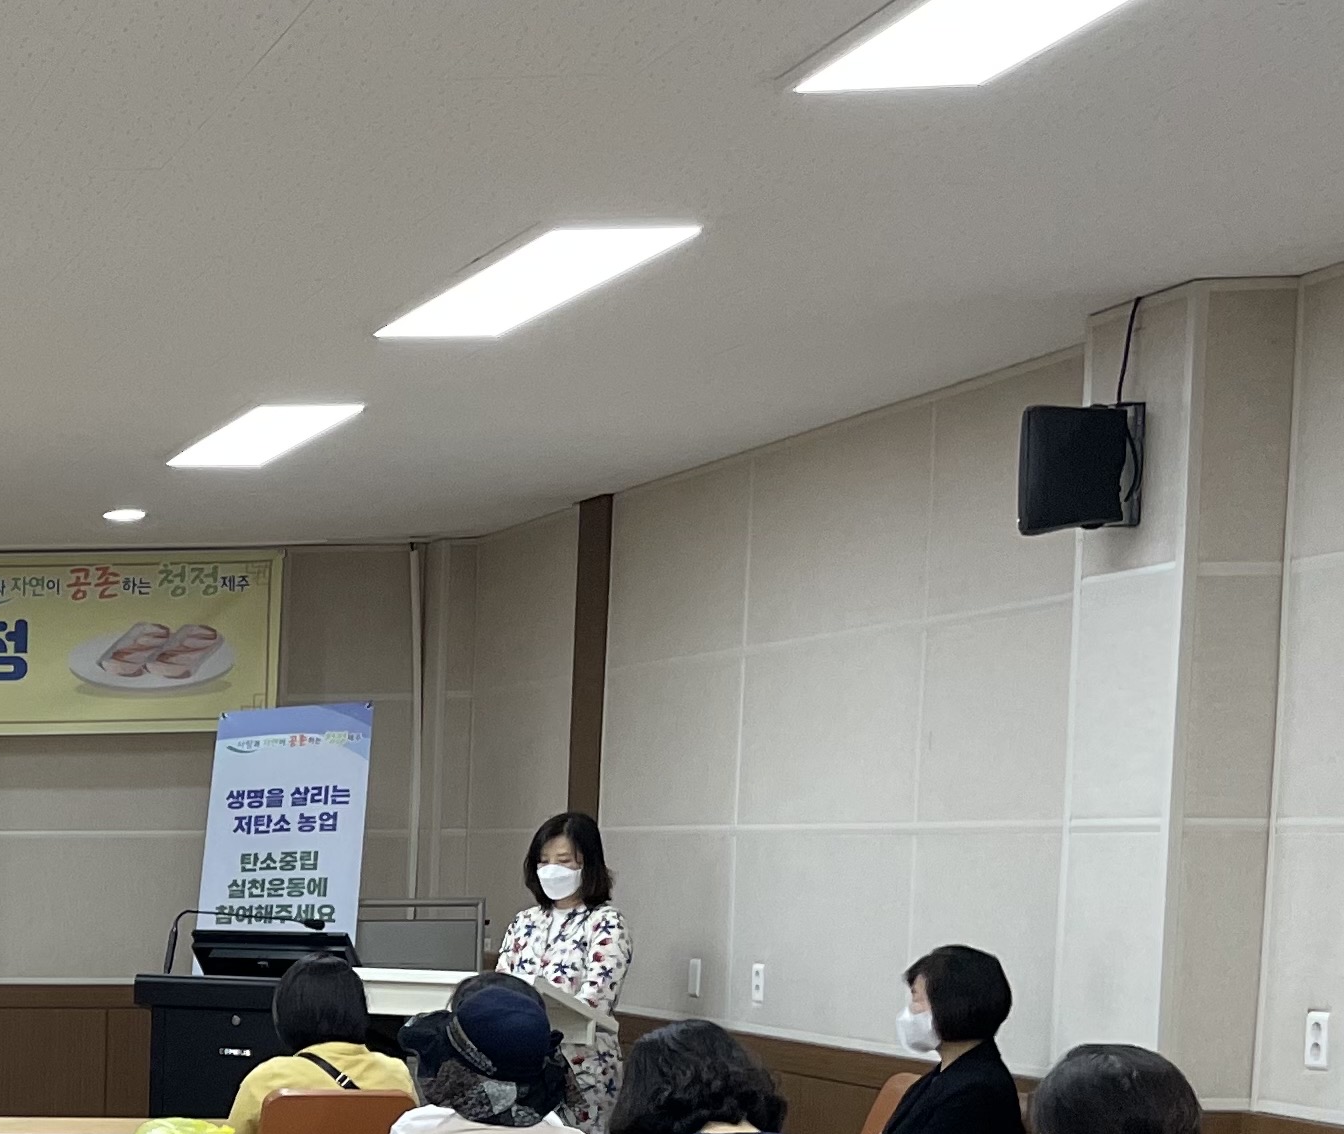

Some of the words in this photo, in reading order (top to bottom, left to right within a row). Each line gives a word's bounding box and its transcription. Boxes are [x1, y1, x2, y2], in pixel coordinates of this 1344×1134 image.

[11, 574, 60, 598] 자연이
[66, 565, 152, 602] 공존하는
[225, 787, 285, 810] 생명을
[290, 784, 351, 807] 살리는
[232, 813, 291, 835] 저탄소
[297, 811, 338, 832] 농업
[239, 850, 319, 873] 탄소중립
[227, 876, 329, 899] 실천운동에
[215, 903, 336, 925] 참여해주세요
